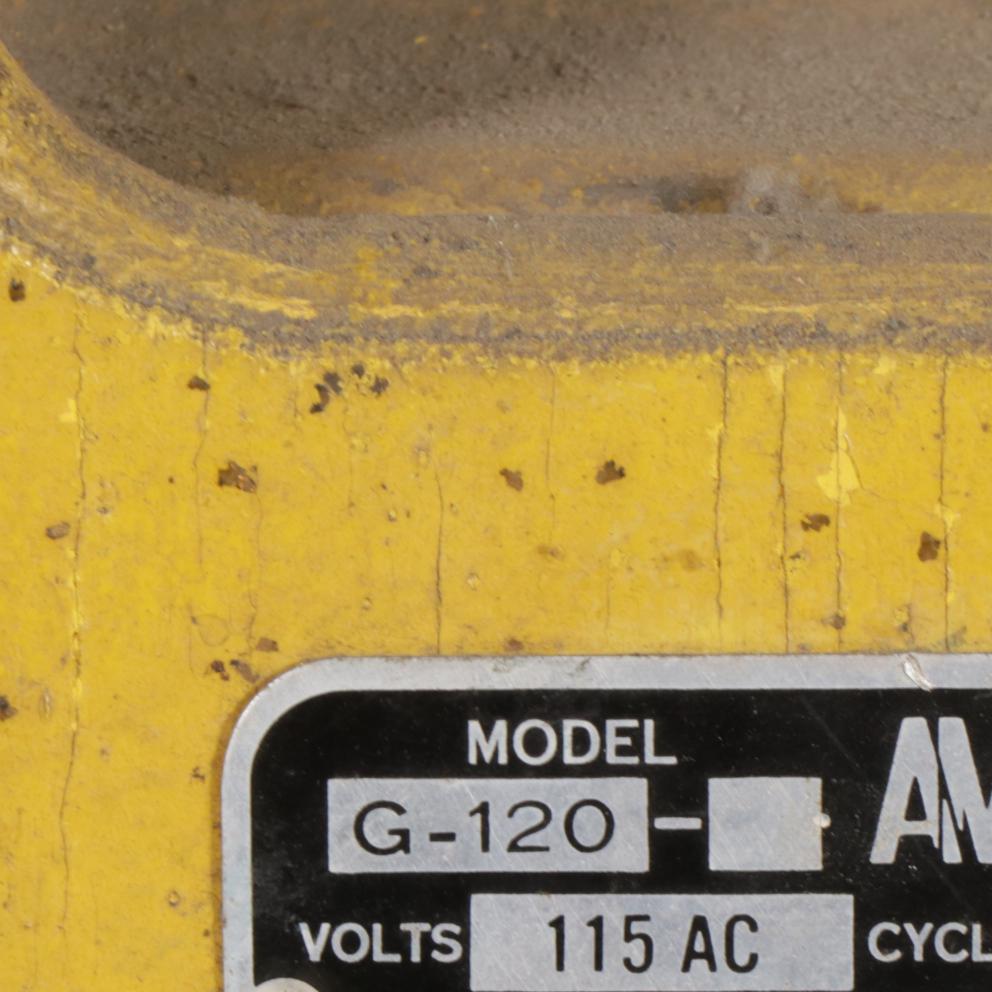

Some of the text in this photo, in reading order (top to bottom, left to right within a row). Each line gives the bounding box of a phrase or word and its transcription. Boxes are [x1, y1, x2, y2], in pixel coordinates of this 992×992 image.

[467, 719, 677, 765] MODEL
[353, 799, 616, 855] G-120
[299, 921, 462, 965] VOLTS
[547, 914, 655, 974] 115
[681, 914, 760, 974] AC
